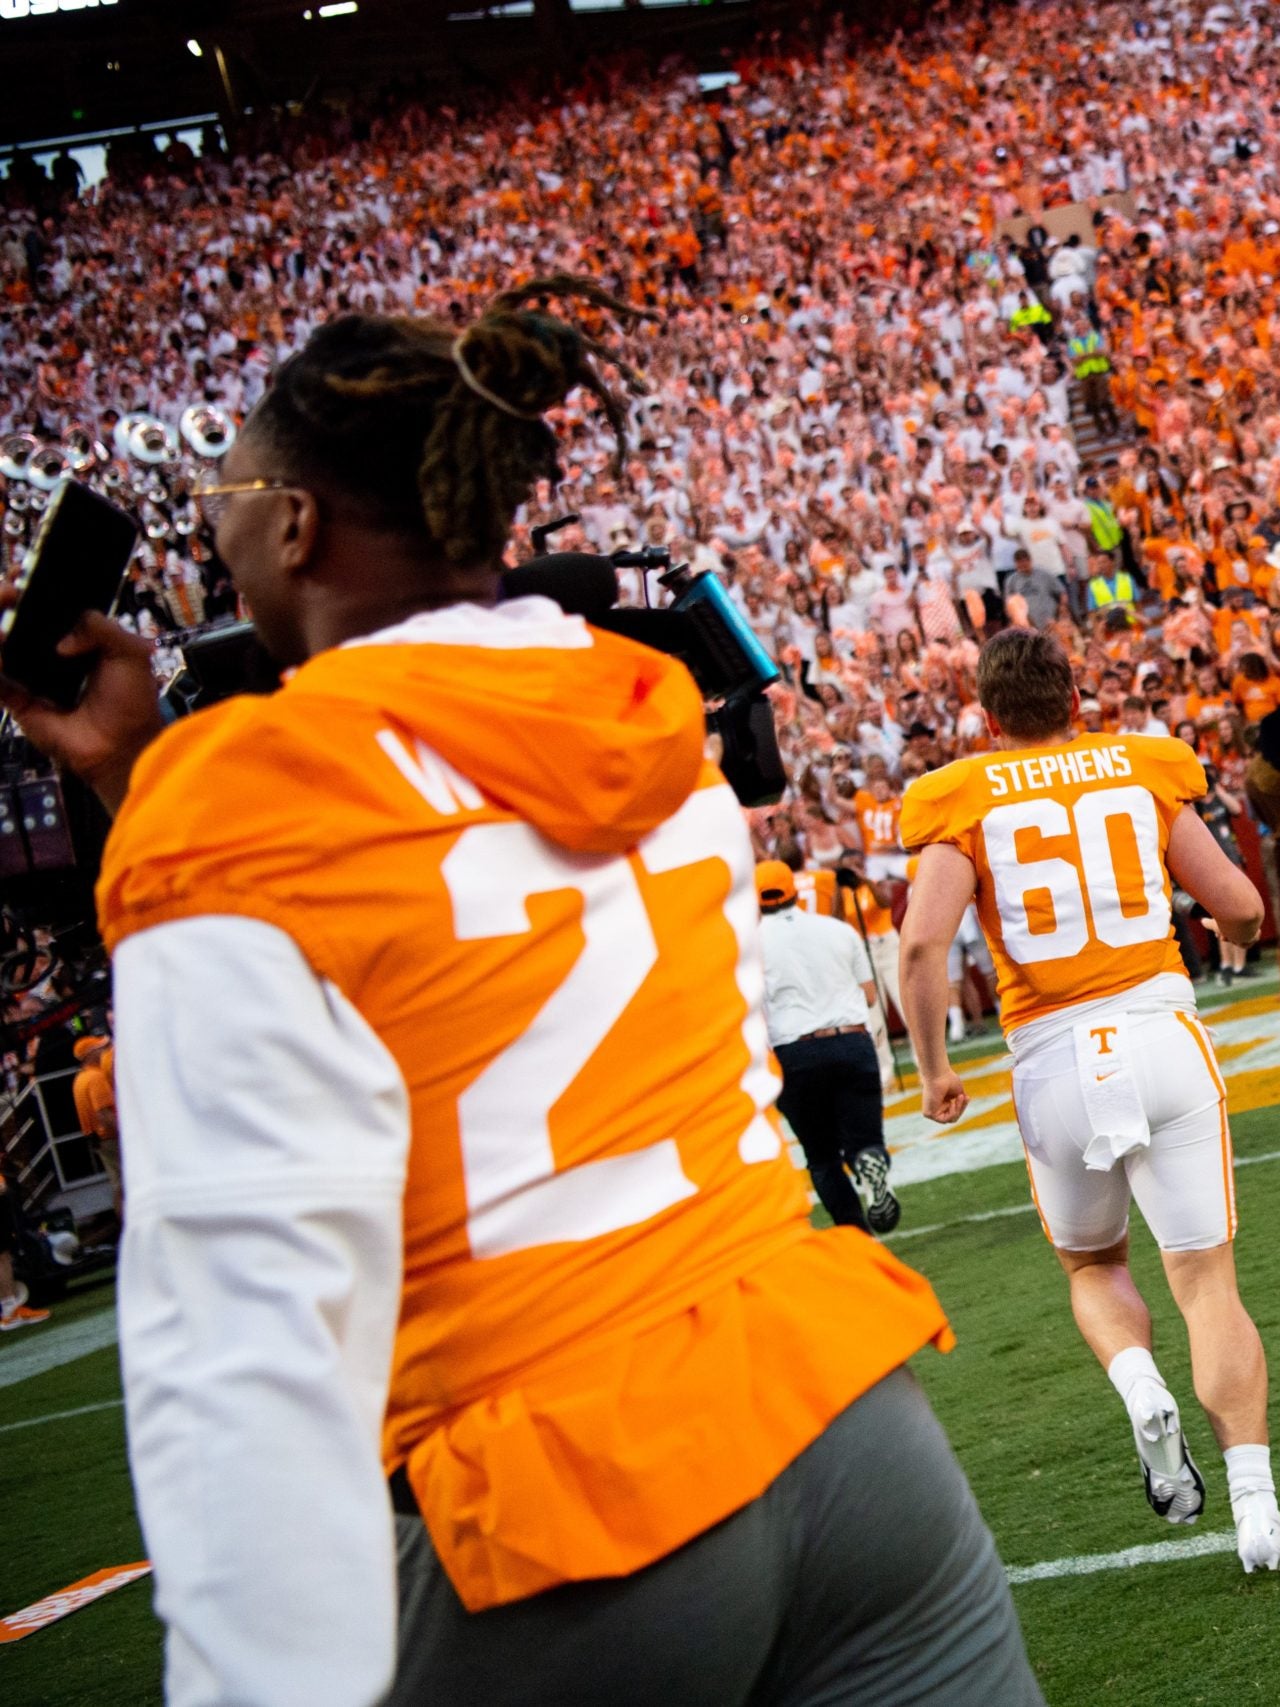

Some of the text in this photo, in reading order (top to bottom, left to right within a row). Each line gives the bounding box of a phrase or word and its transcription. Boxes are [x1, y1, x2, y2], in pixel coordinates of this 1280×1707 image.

[985, 745, 1132, 797] STEPHENS
[981, 785, 1172, 965] 60
[1090, 1026, 1117, 1054] T
